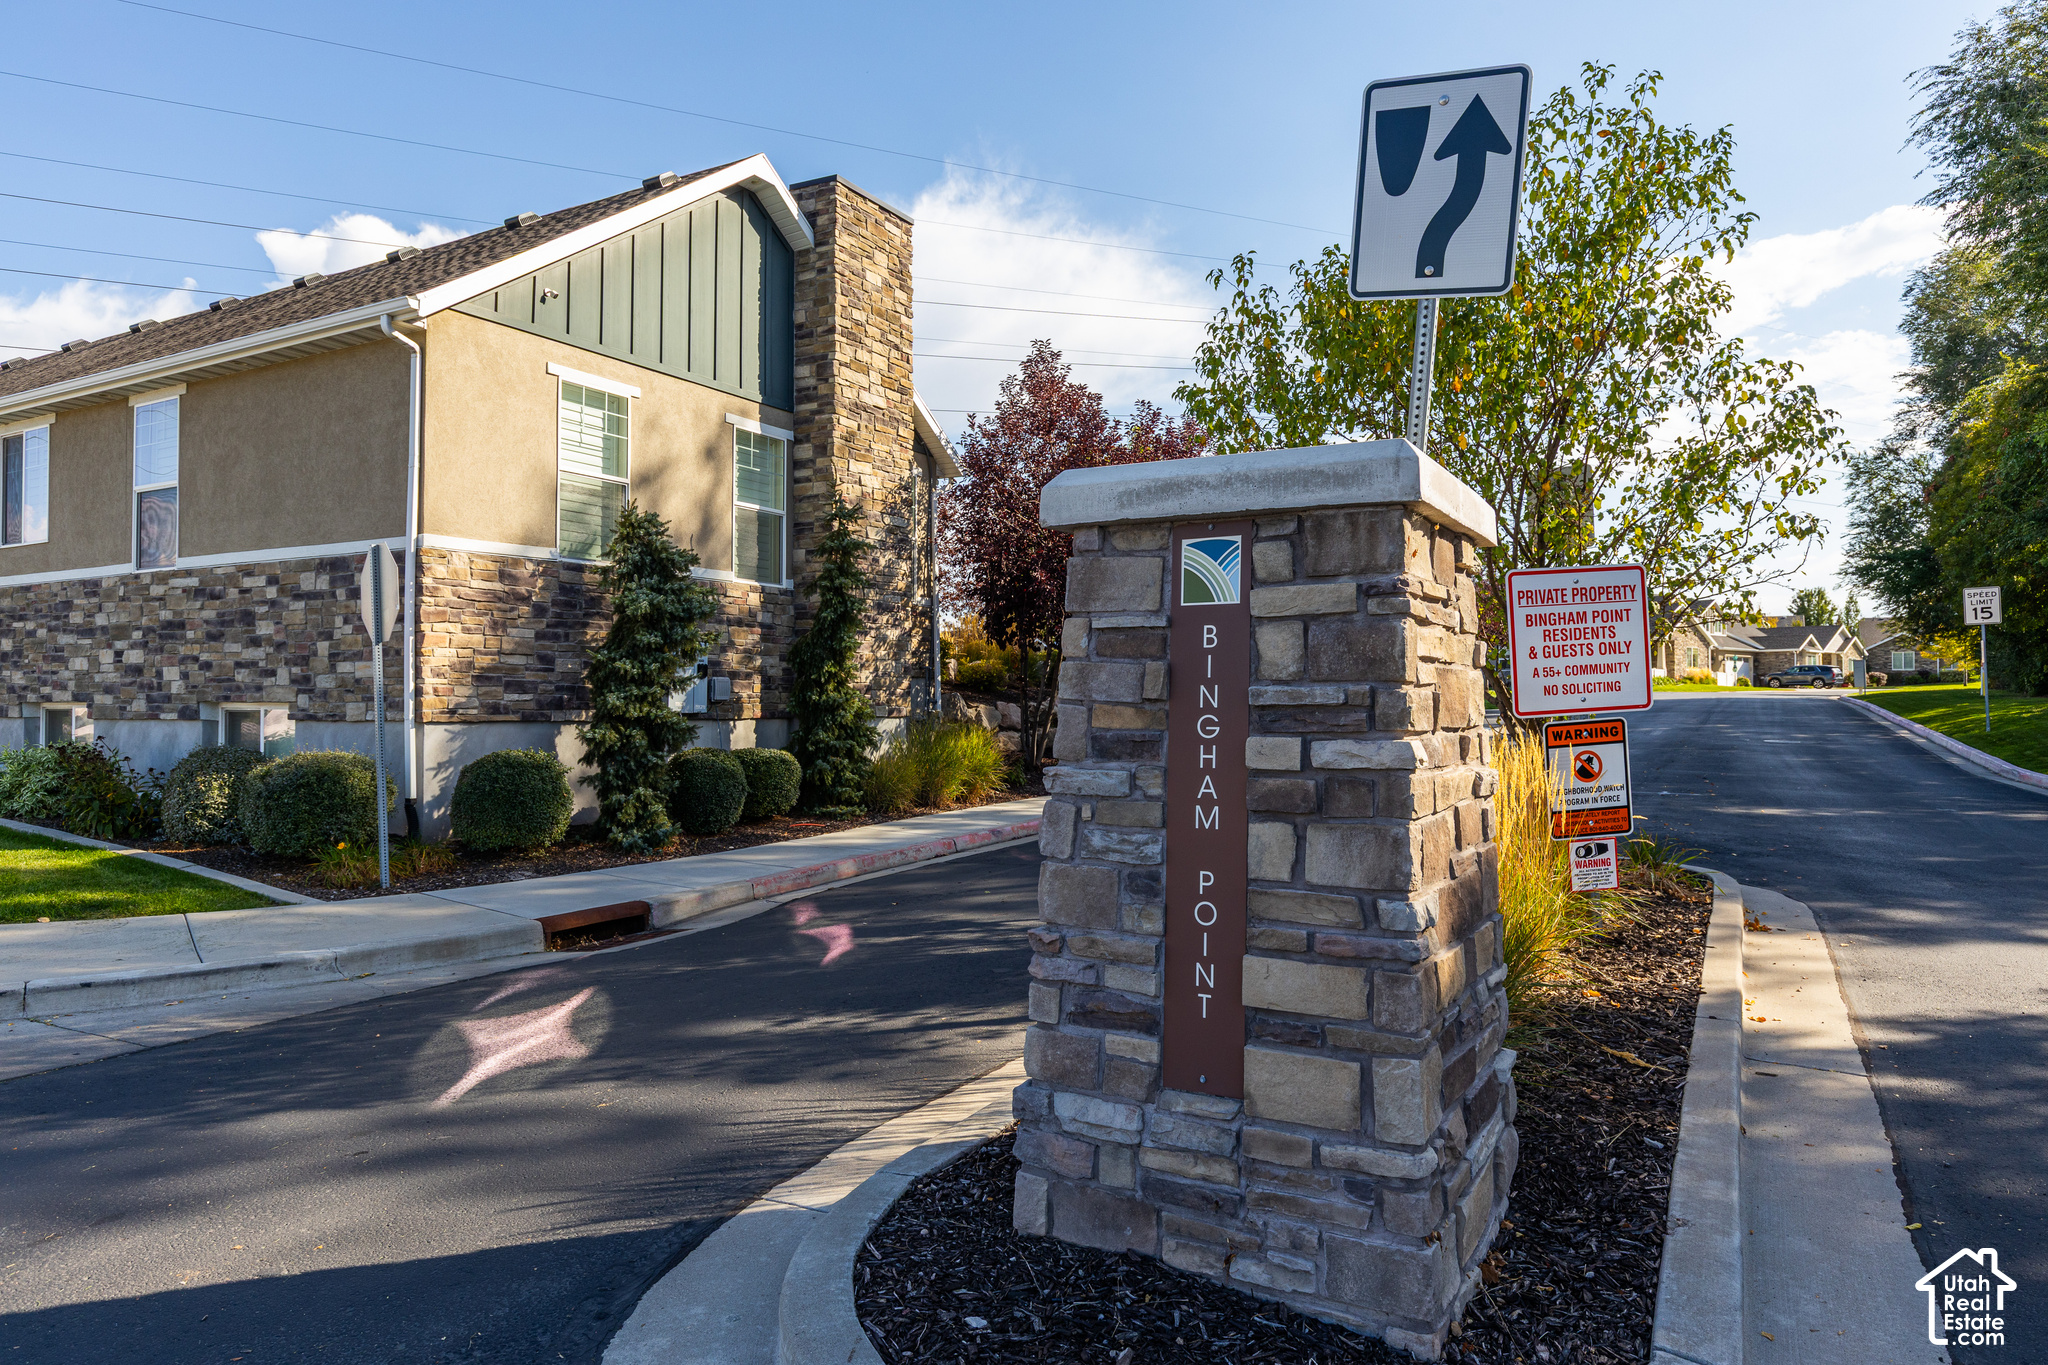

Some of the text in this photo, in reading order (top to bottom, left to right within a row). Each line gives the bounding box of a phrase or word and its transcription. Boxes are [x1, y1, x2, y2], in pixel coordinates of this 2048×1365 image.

[1517, 584, 1637, 605] PRIVATE PROPERTY
[1525, 608, 1631, 627] BINGHAM POINT
[1972, 607, 1993, 620] 15
[1542, 625, 1616, 642] RESIDENTS
[1528, 640, 1632, 660] & GUESTS ONLY
[1532, 661, 1631, 678] A 55+ COMMUNITY
[1543, 681, 1622, 696] NO SOLICITING
[1552, 726, 1619, 742] WARNING
[1556, 784, 1625, 797] GHBORHOOD WATCH
[1559, 795, 1621, 806] POGRAM IN FORCE
[1194, 624, 1220, 1019] BINGHAM POINT
[1574, 858, 1611, 869] WARNING
